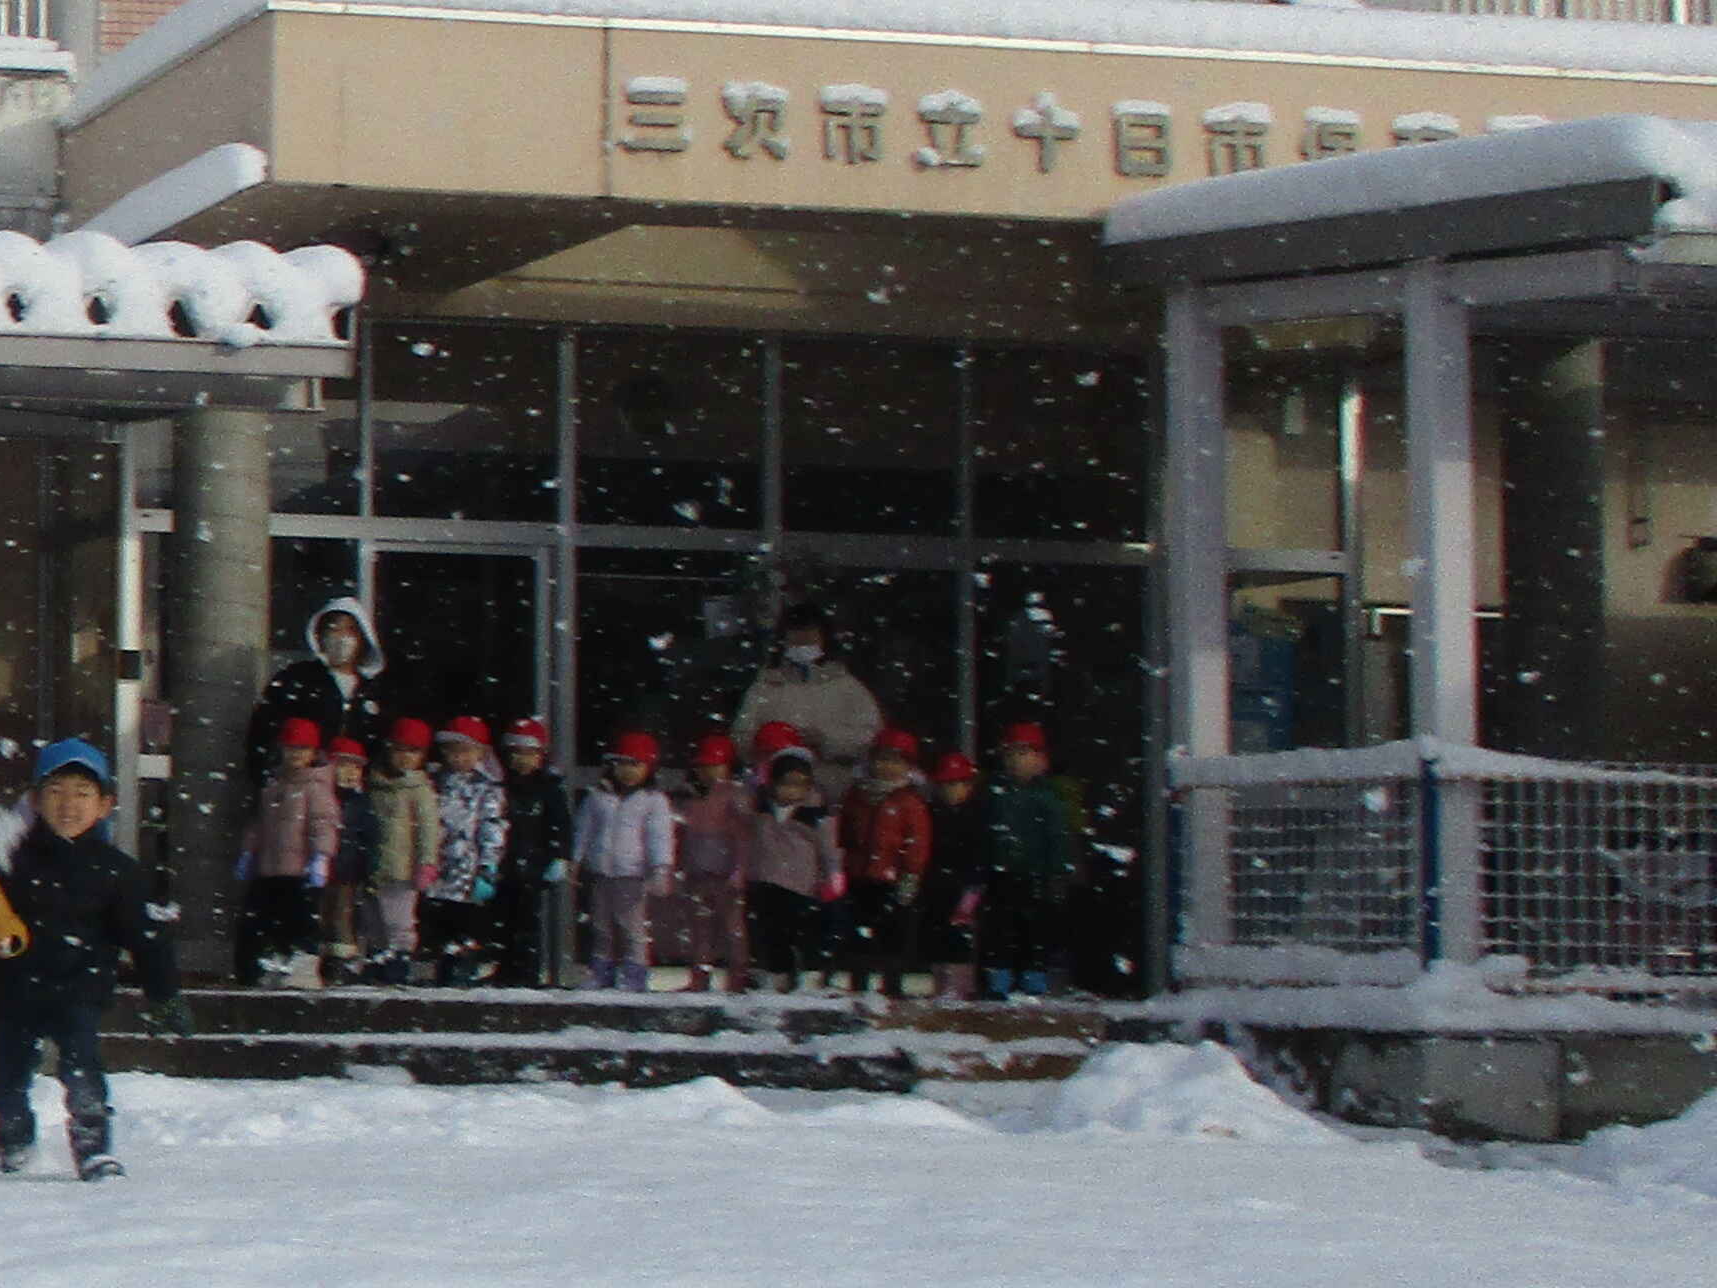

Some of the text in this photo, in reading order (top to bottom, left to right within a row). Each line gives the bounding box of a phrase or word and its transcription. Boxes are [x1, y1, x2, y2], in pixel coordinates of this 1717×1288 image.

[618, 76, 1551, 178] 三次市立十日市保
